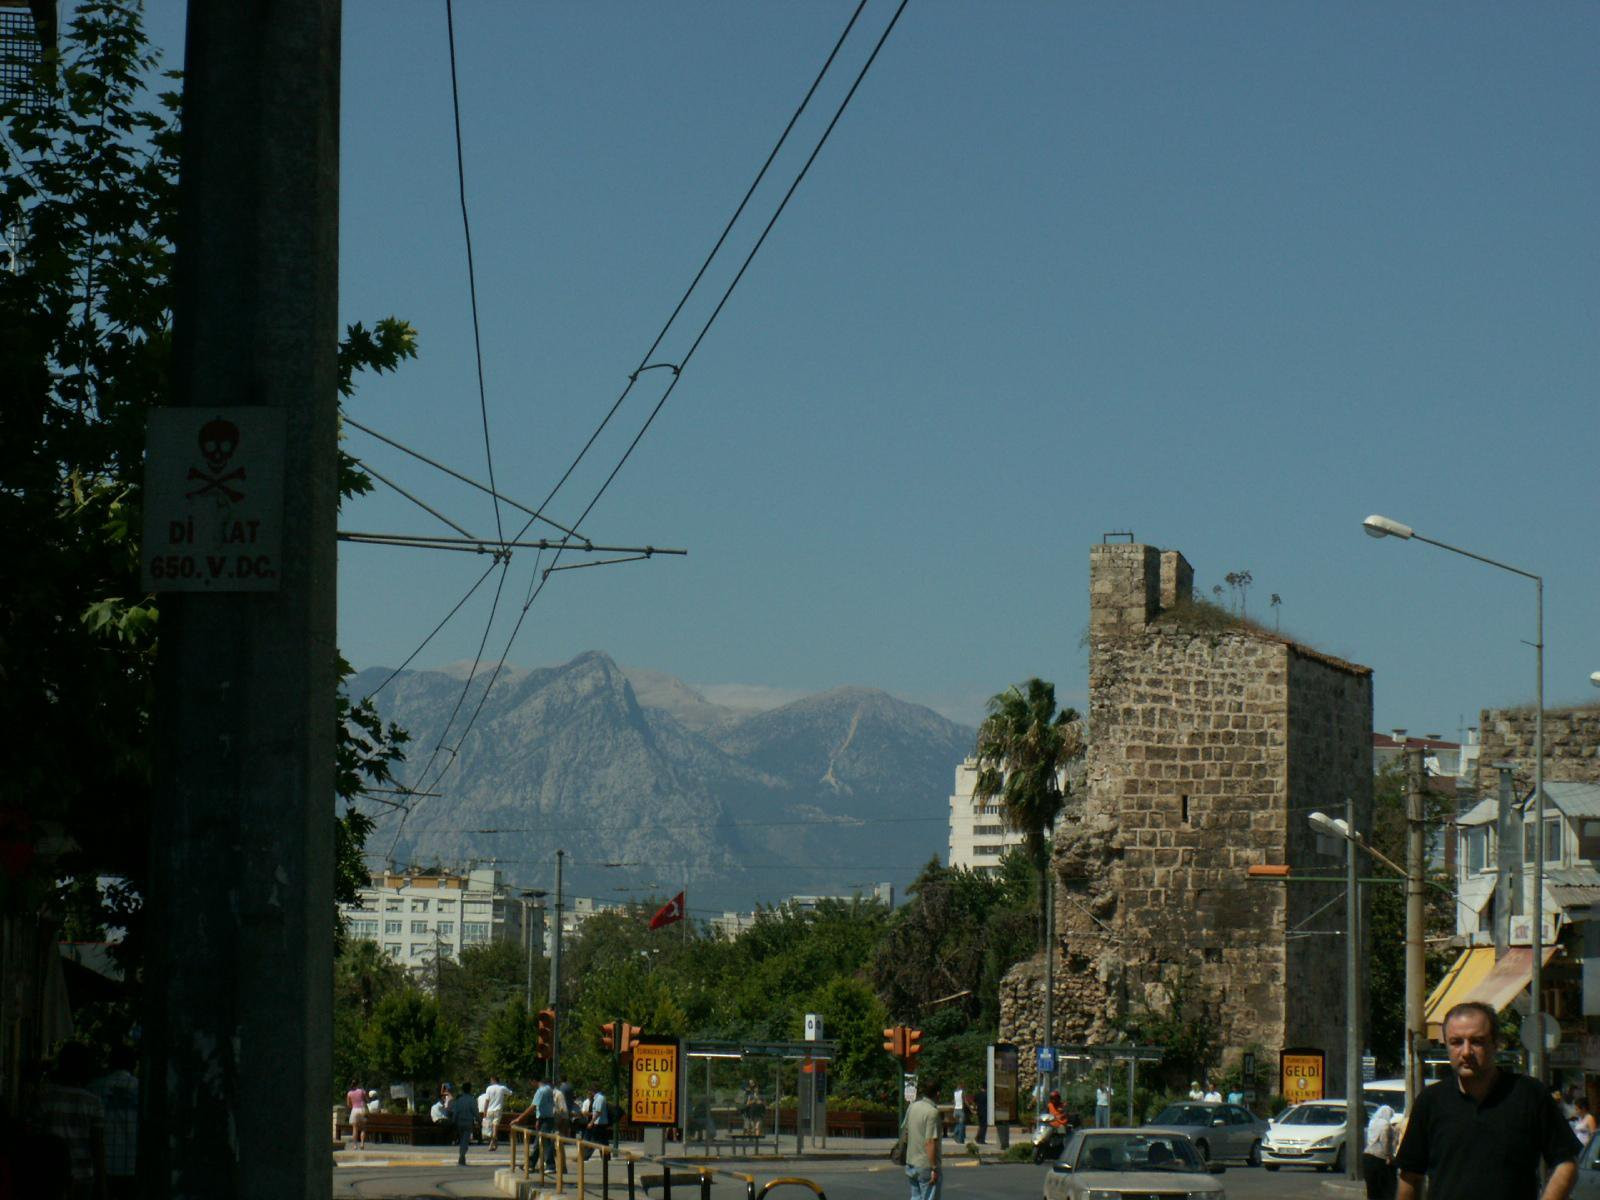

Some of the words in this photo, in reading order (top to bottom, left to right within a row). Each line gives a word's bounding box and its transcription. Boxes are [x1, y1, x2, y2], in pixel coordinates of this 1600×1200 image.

[169, 515, 260, 544] DİAT
[636, 1056, 673, 1073] GELDİ
[1286, 1064, 1320, 1077] GELDİ
[635, 1098, 673, 1115] GİTTİ
